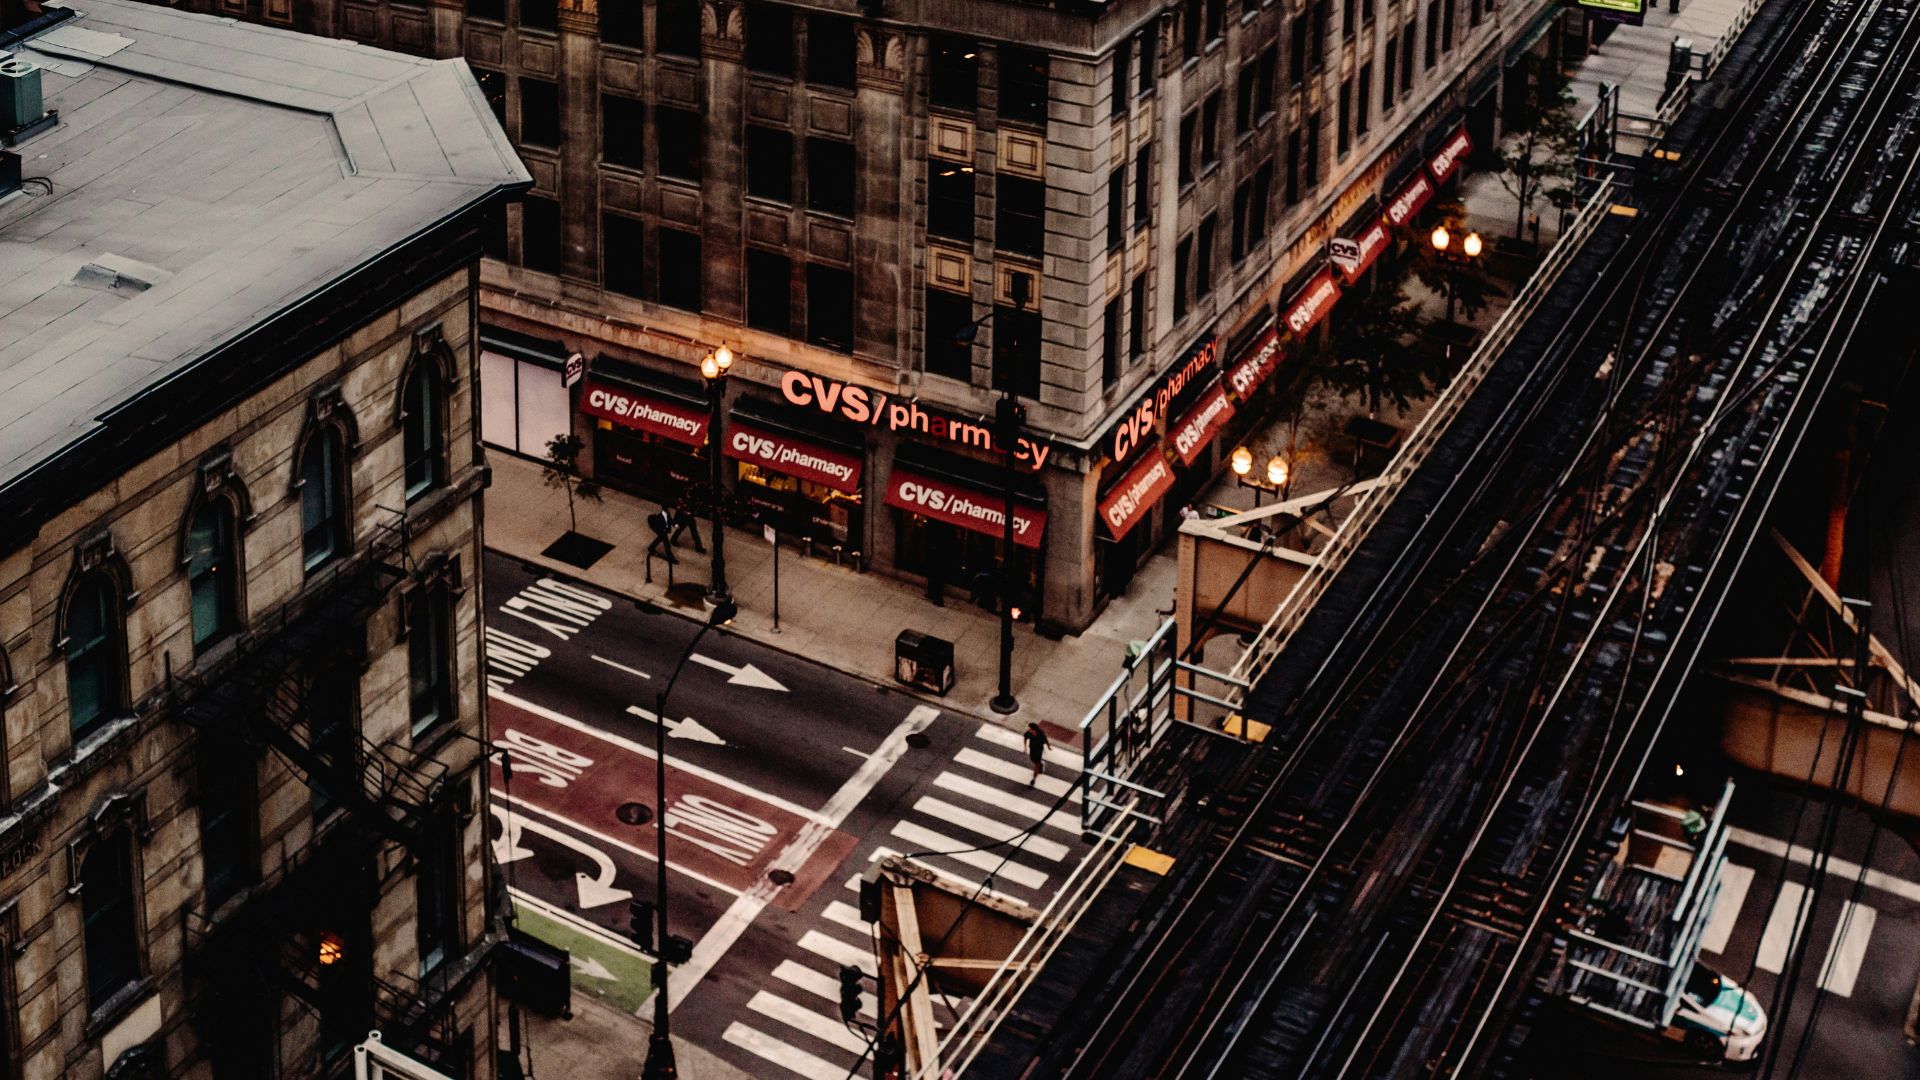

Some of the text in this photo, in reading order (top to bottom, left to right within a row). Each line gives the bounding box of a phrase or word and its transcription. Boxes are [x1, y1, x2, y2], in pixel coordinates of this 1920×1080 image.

[1331, 243, 1358, 257] CVS
[1289, 279, 1335, 332] CVS/pharmacy
[567, 357, 582, 376] CVS
[589, 389, 701, 436] CVS/pharmacy
[1114, 335, 1218, 463] CVS/pharmacy
[1176, 393, 1229, 455] CVS/pharmacy
[732, 431, 853, 482] CVS/pharmacy
[1108, 460, 1167, 527] CVS/pharmacy
[499, 578, 613, 641] ONLY
[489, 728, 594, 788] BUS
[652, 794, 779, 866] ONLY
